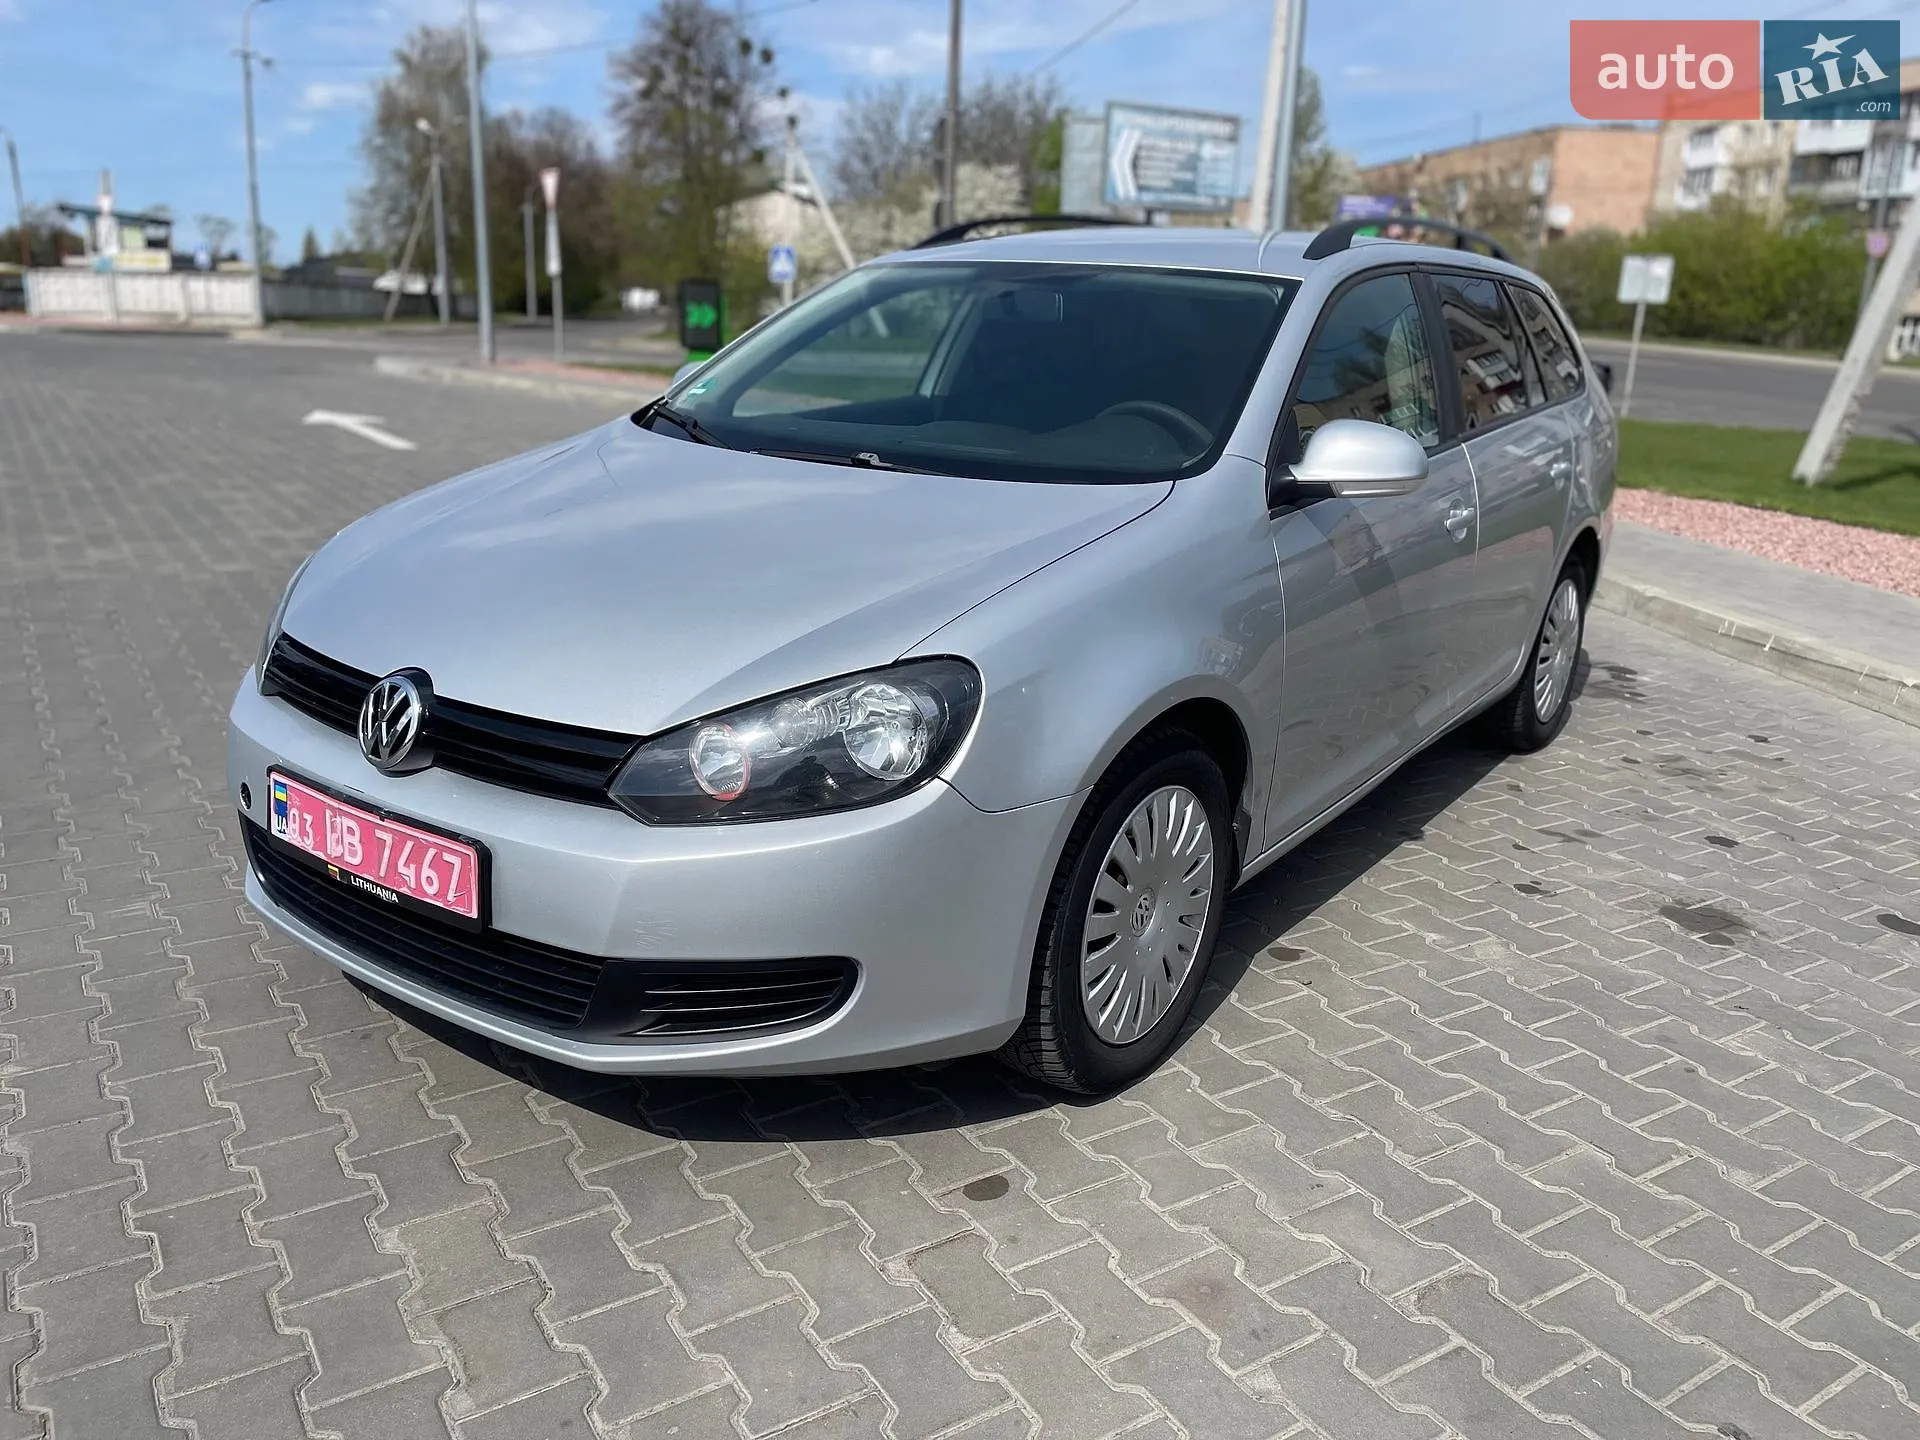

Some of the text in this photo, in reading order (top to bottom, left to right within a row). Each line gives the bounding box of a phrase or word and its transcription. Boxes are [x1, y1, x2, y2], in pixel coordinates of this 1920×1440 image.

[275, 814, 289, 833] UA
[374, 829, 462, 902] 7467
[350, 876, 399, 904] LITHUANIA
